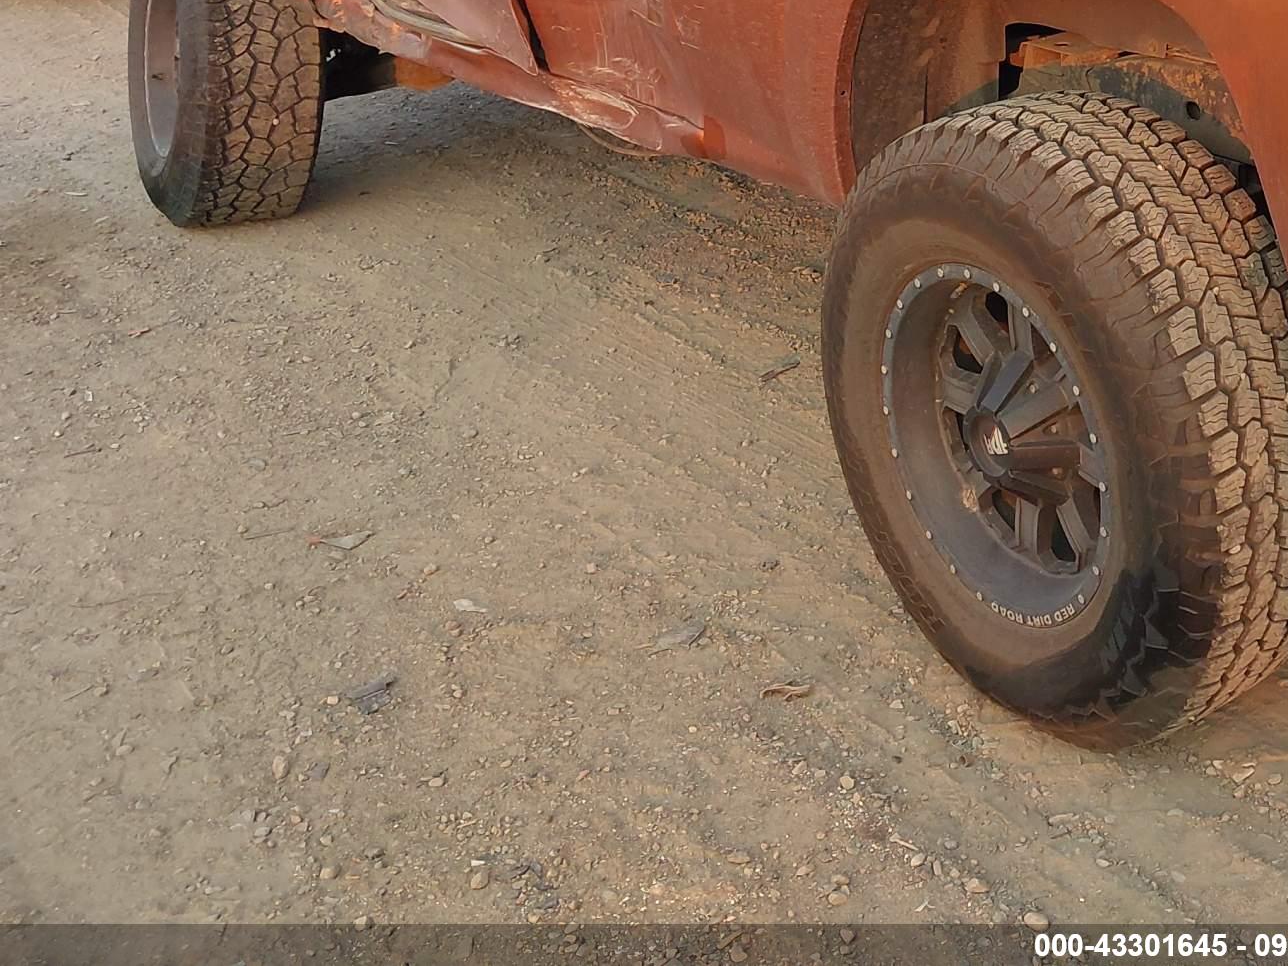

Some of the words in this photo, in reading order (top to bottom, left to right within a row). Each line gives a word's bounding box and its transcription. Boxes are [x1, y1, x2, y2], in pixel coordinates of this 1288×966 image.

[991, 601, 1024, 624] ROAD
[1026, 614, 1052, 627] DIRT
[1053, 603, 1075, 623] RED
